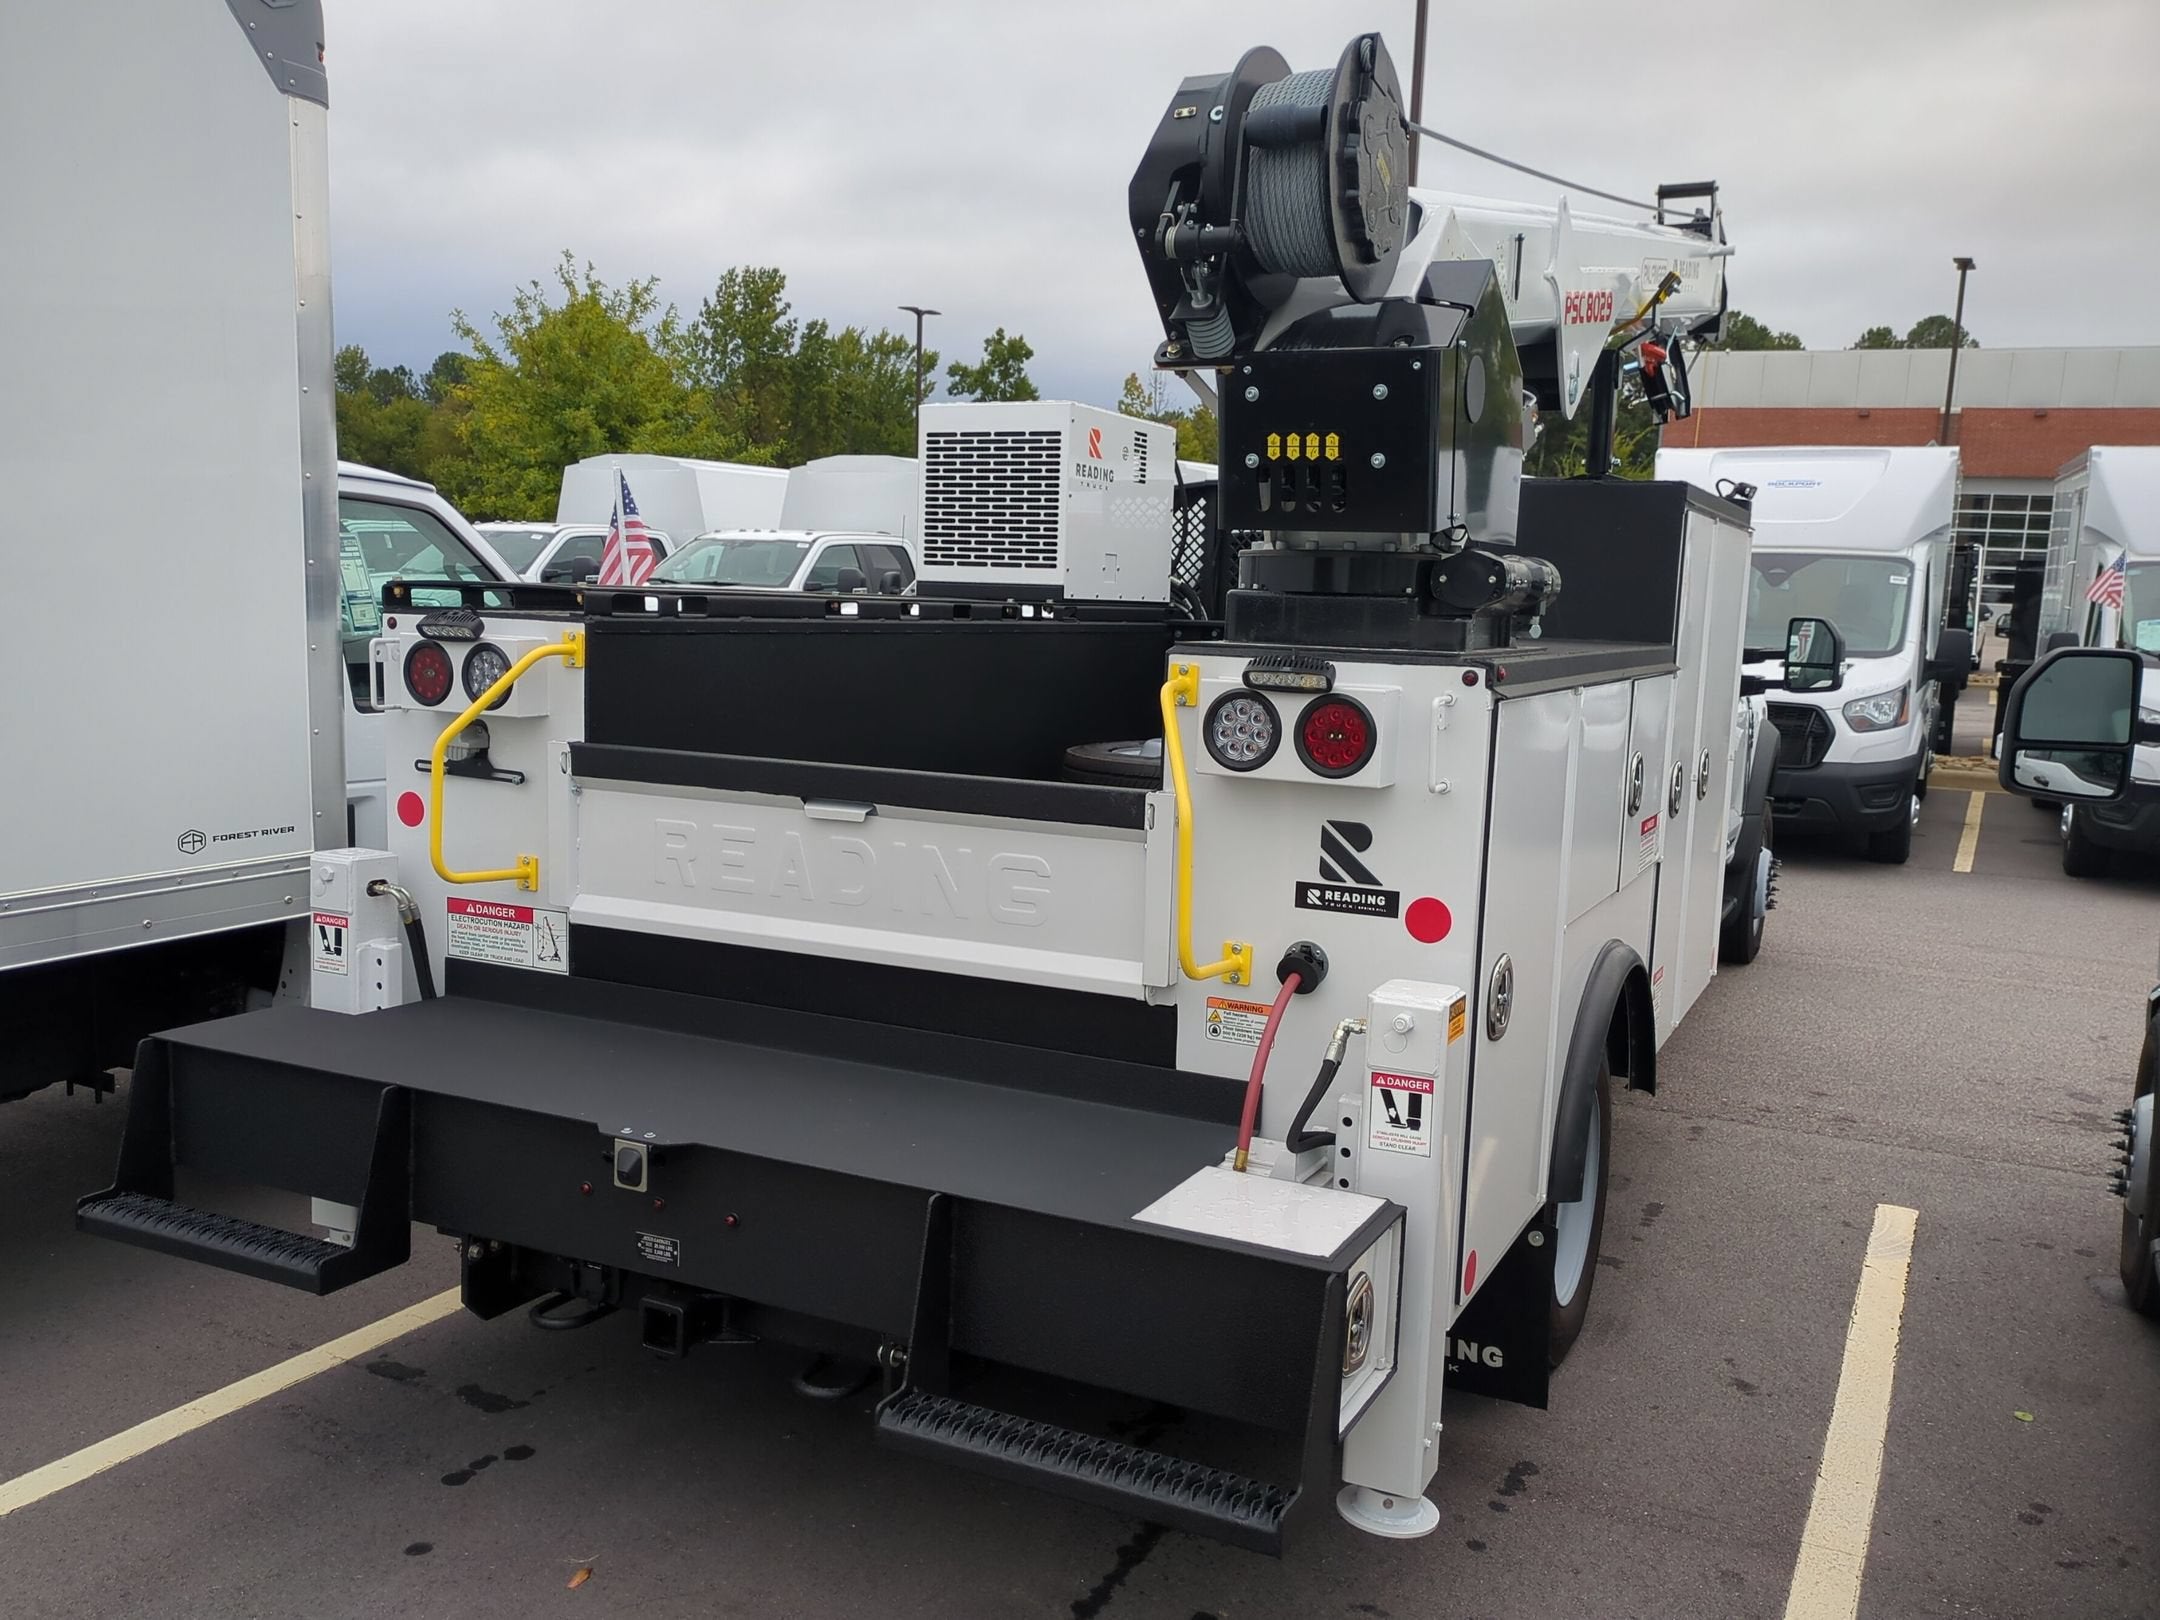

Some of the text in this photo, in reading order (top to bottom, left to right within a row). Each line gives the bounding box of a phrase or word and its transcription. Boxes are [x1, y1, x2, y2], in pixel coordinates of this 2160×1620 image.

[1565, 290, 1613, 325] PSC 8029
[1075, 463, 1114, 483] READING
[212, 825, 295, 843] FOREST RIVER
[655, 819, 1051, 927] READING
[1324, 890, 1386, 906] READING
[476, 904, 516, 918] DANGER
[322, 916, 347, 925] DANGER
[451, 914, 530, 931] ELECTROCUTION HAZARD
[1227, 1002, 1264, 1013] WARNING
[1387, 1077, 1430, 1091] DANGER
[1398, 1143, 1416, 1151] CLEAR
